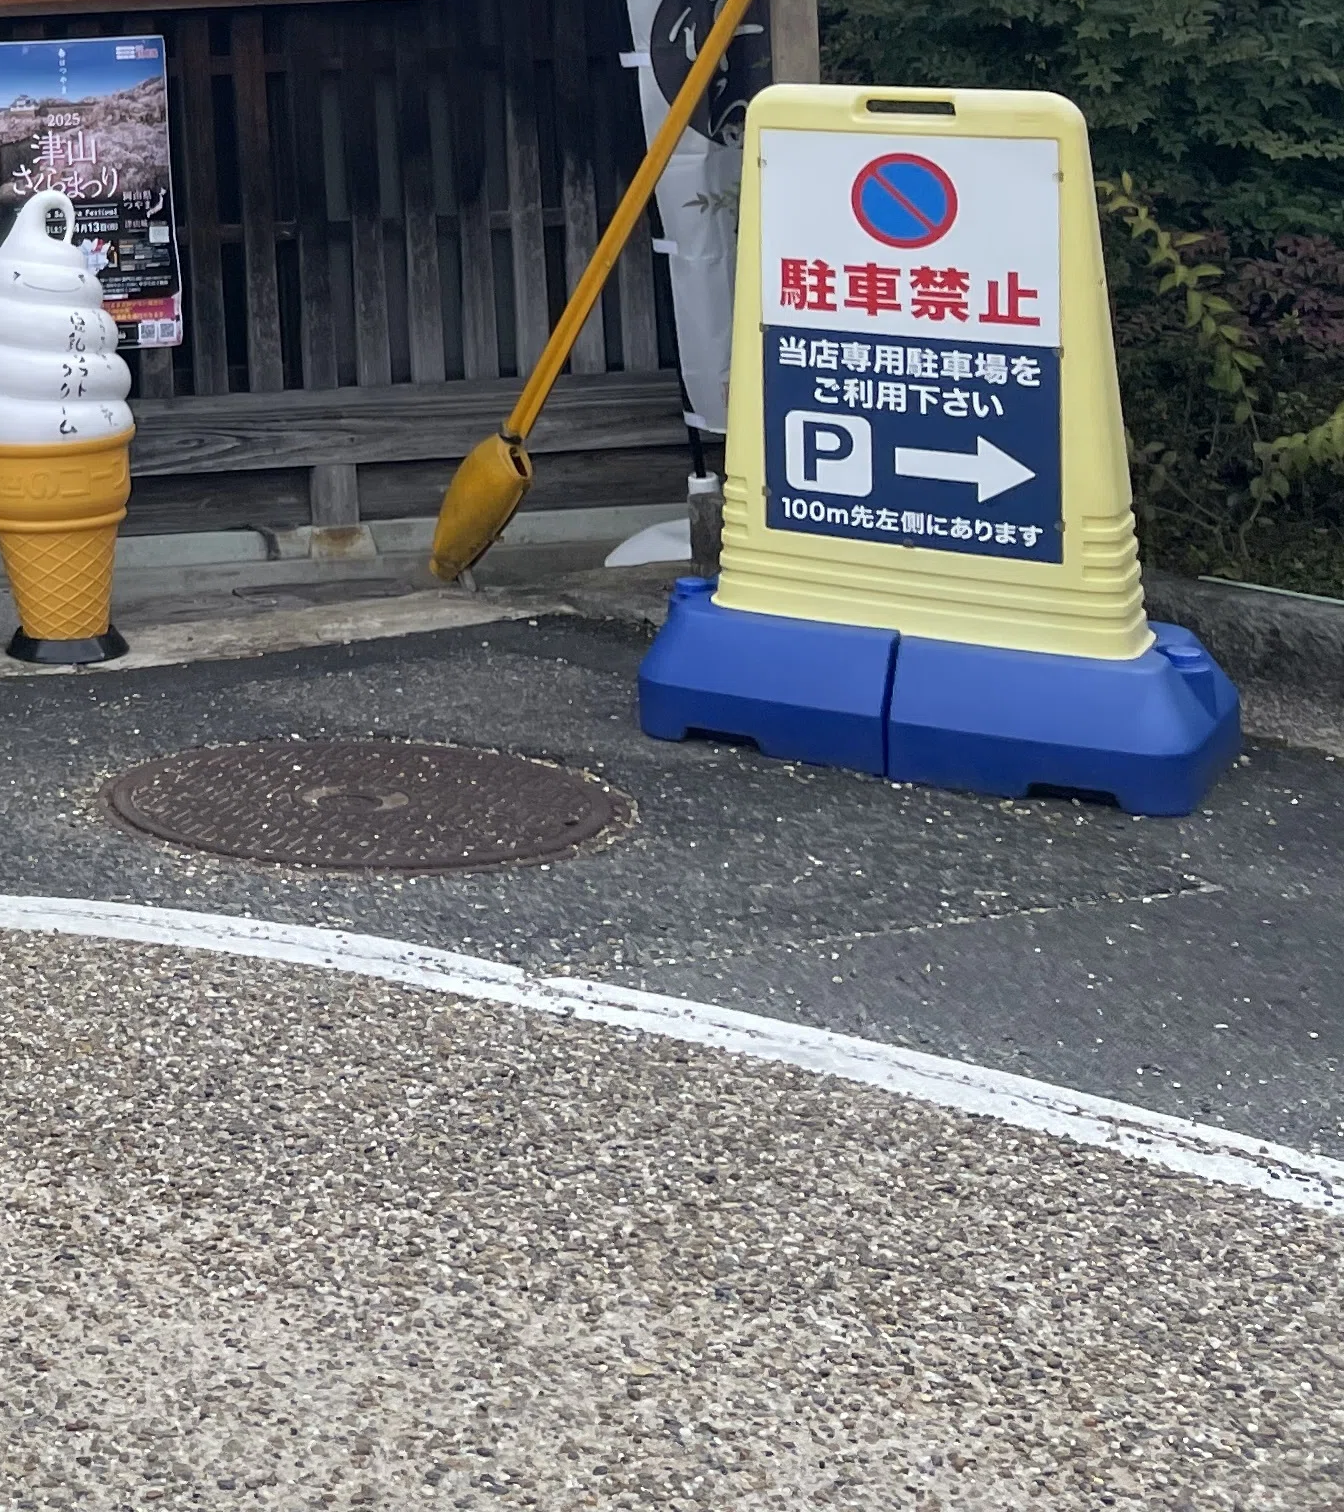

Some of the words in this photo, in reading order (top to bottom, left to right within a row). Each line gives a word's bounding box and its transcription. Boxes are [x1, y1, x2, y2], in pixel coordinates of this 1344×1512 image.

[47, 112, 81, 127] 2025
[31, 129, 97, 166] 津山
[12, 164, 118, 199] さくらまつり
[780, 257, 1041, 327] 駐車禁止
[778, 336, 1041, 388] 当店専用駐車場を
[813, 376, 1004, 419] ご利用下さい
[803, 420, 854, 483] P
[782, 496, 1043, 548] 100m先左側にあります
